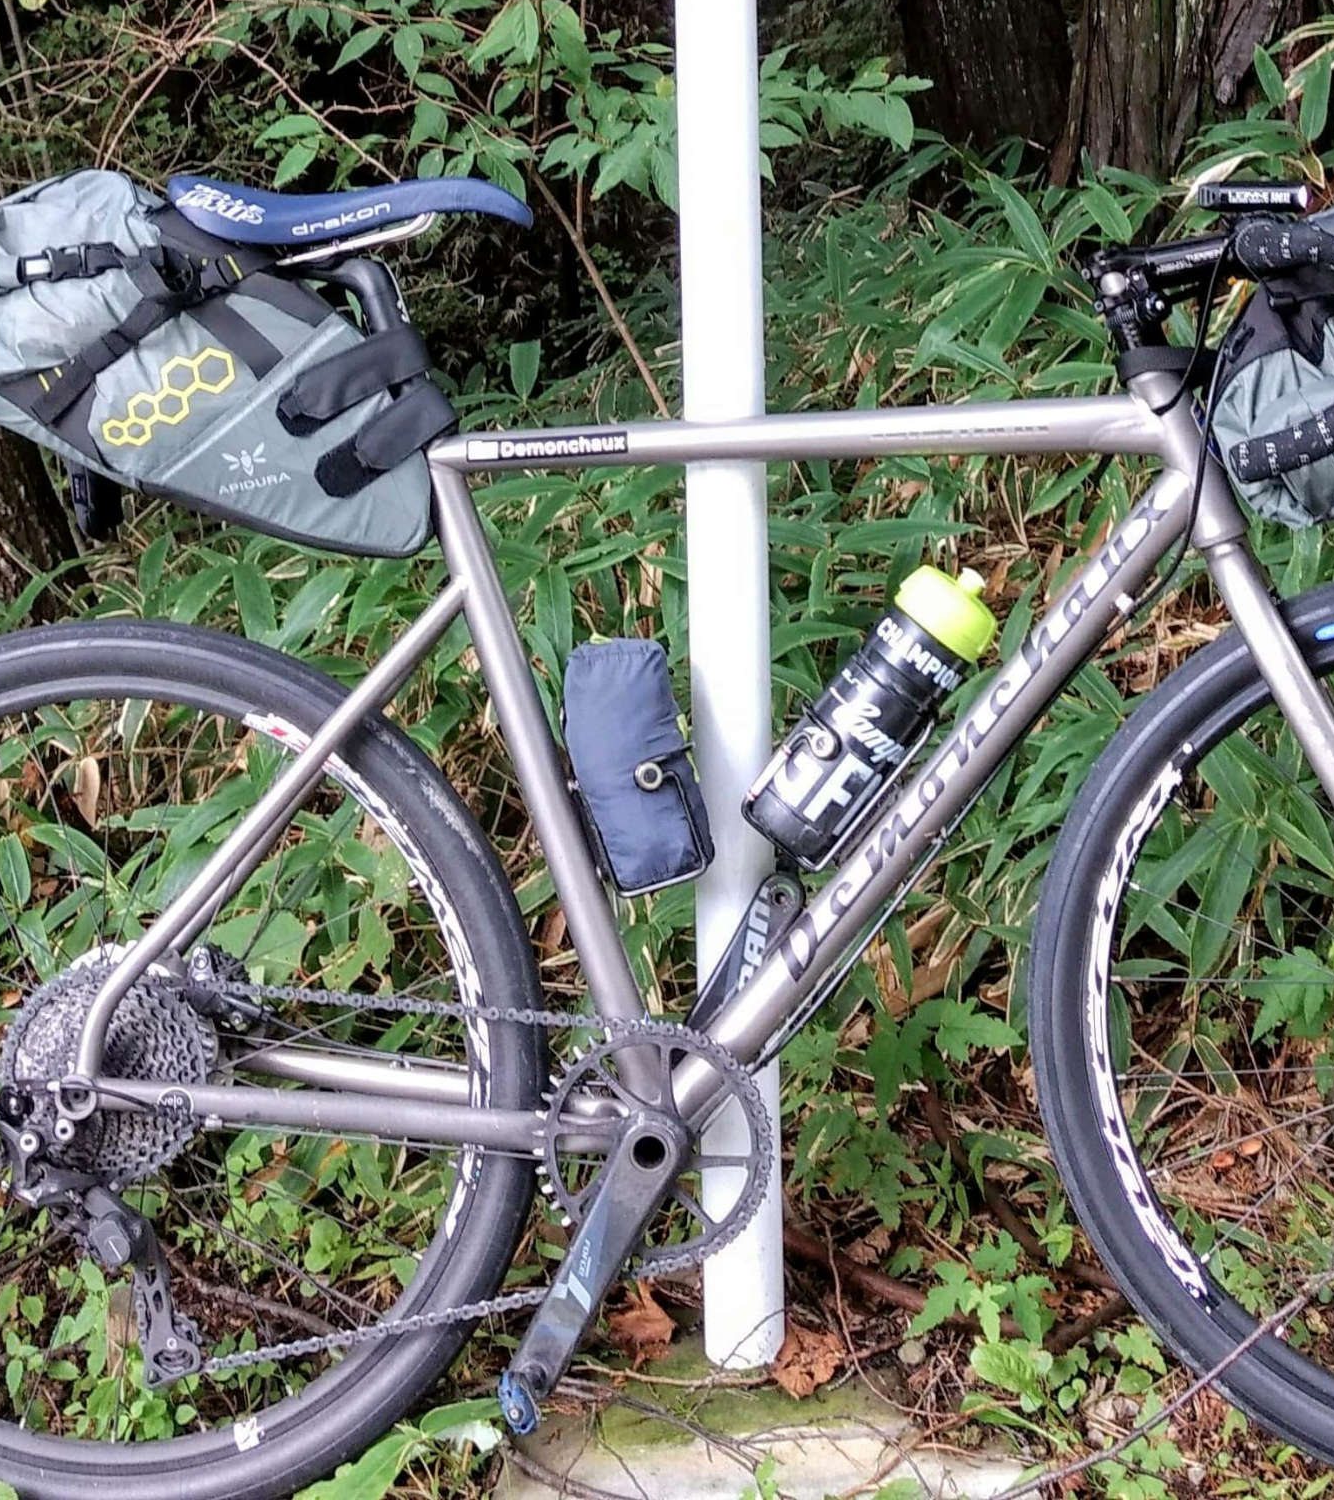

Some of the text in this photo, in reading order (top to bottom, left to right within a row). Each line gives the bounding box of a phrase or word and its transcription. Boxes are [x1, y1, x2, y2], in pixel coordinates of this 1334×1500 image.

[291, 201, 391, 237] drakon
[501, 436, 625, 458] Demonchaux
[219, 472, 292, 496] APIDURA
[876, 617, 964, 693] CHAMPION
